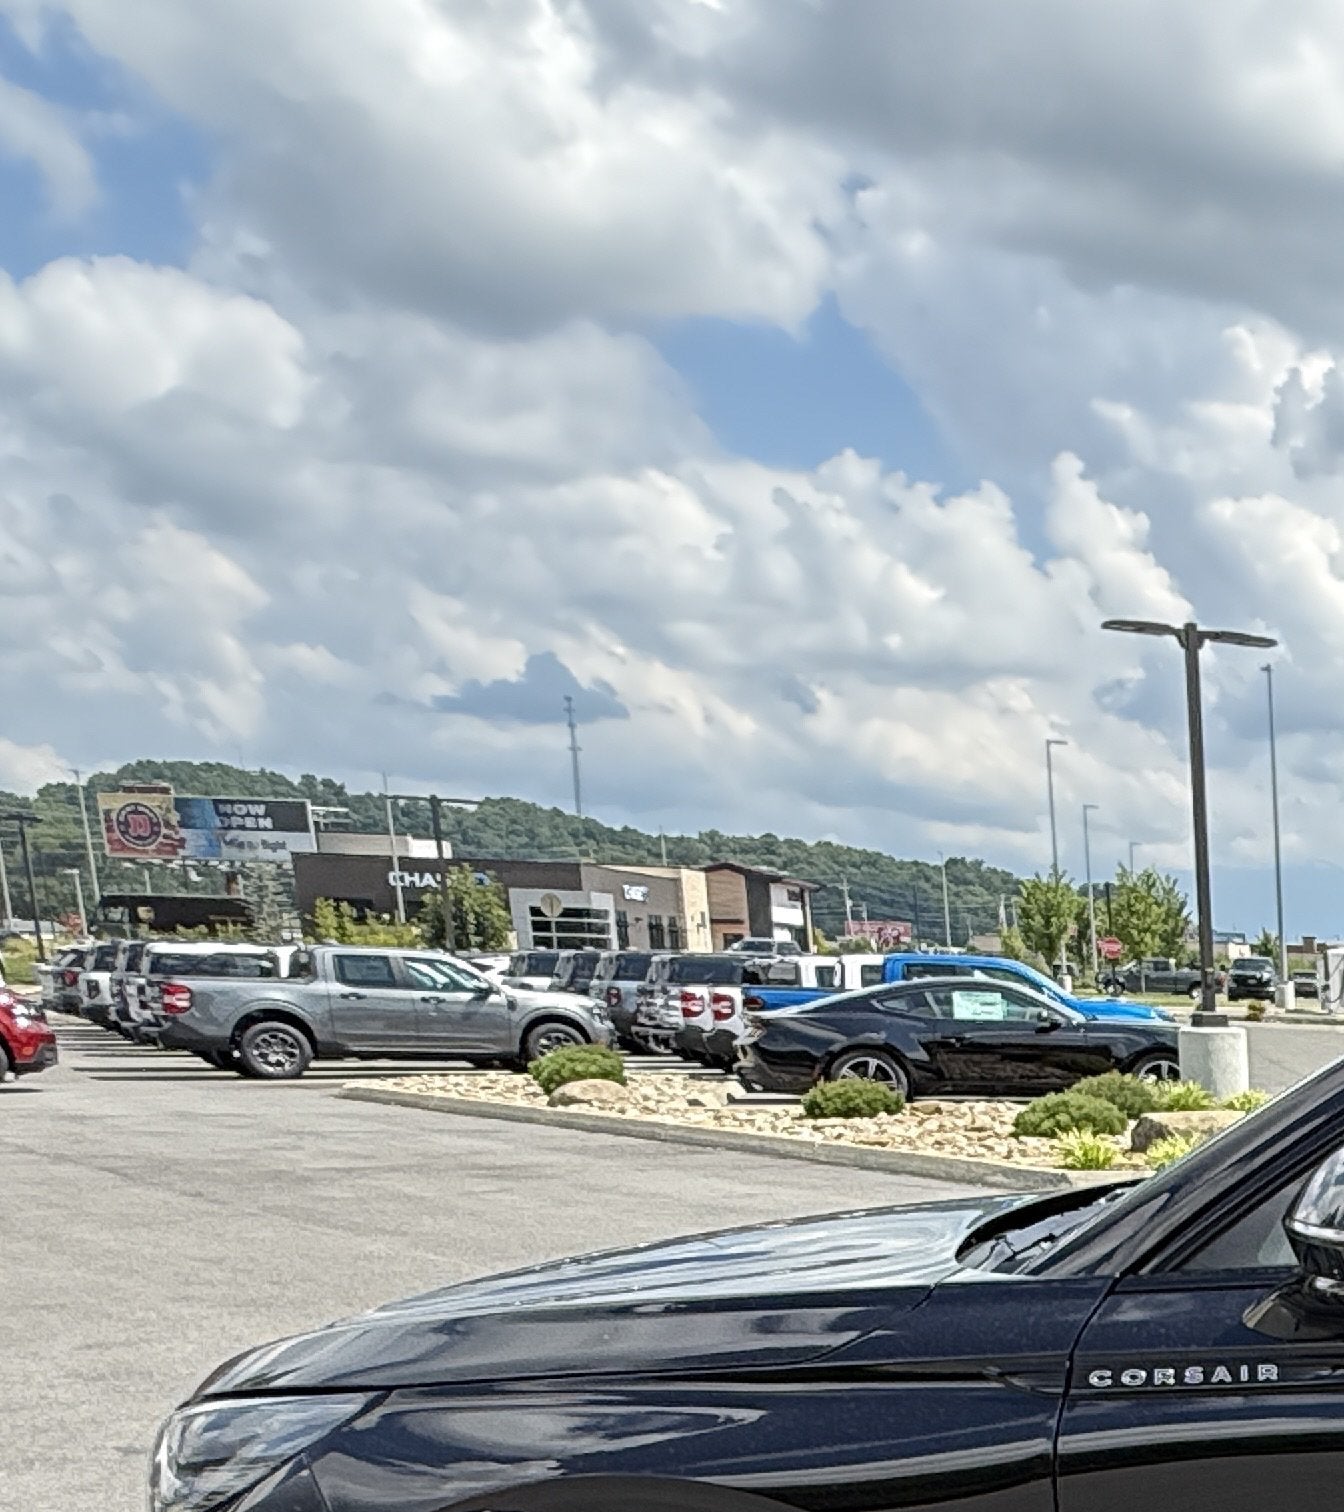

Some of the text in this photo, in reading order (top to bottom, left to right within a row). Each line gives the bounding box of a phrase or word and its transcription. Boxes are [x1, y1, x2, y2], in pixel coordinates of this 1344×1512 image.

[219, 804, 266, 815] NOW
[219, 817, 273, 829] OPEN
[1089, 1364, 1278, 1386] CORSAIR
